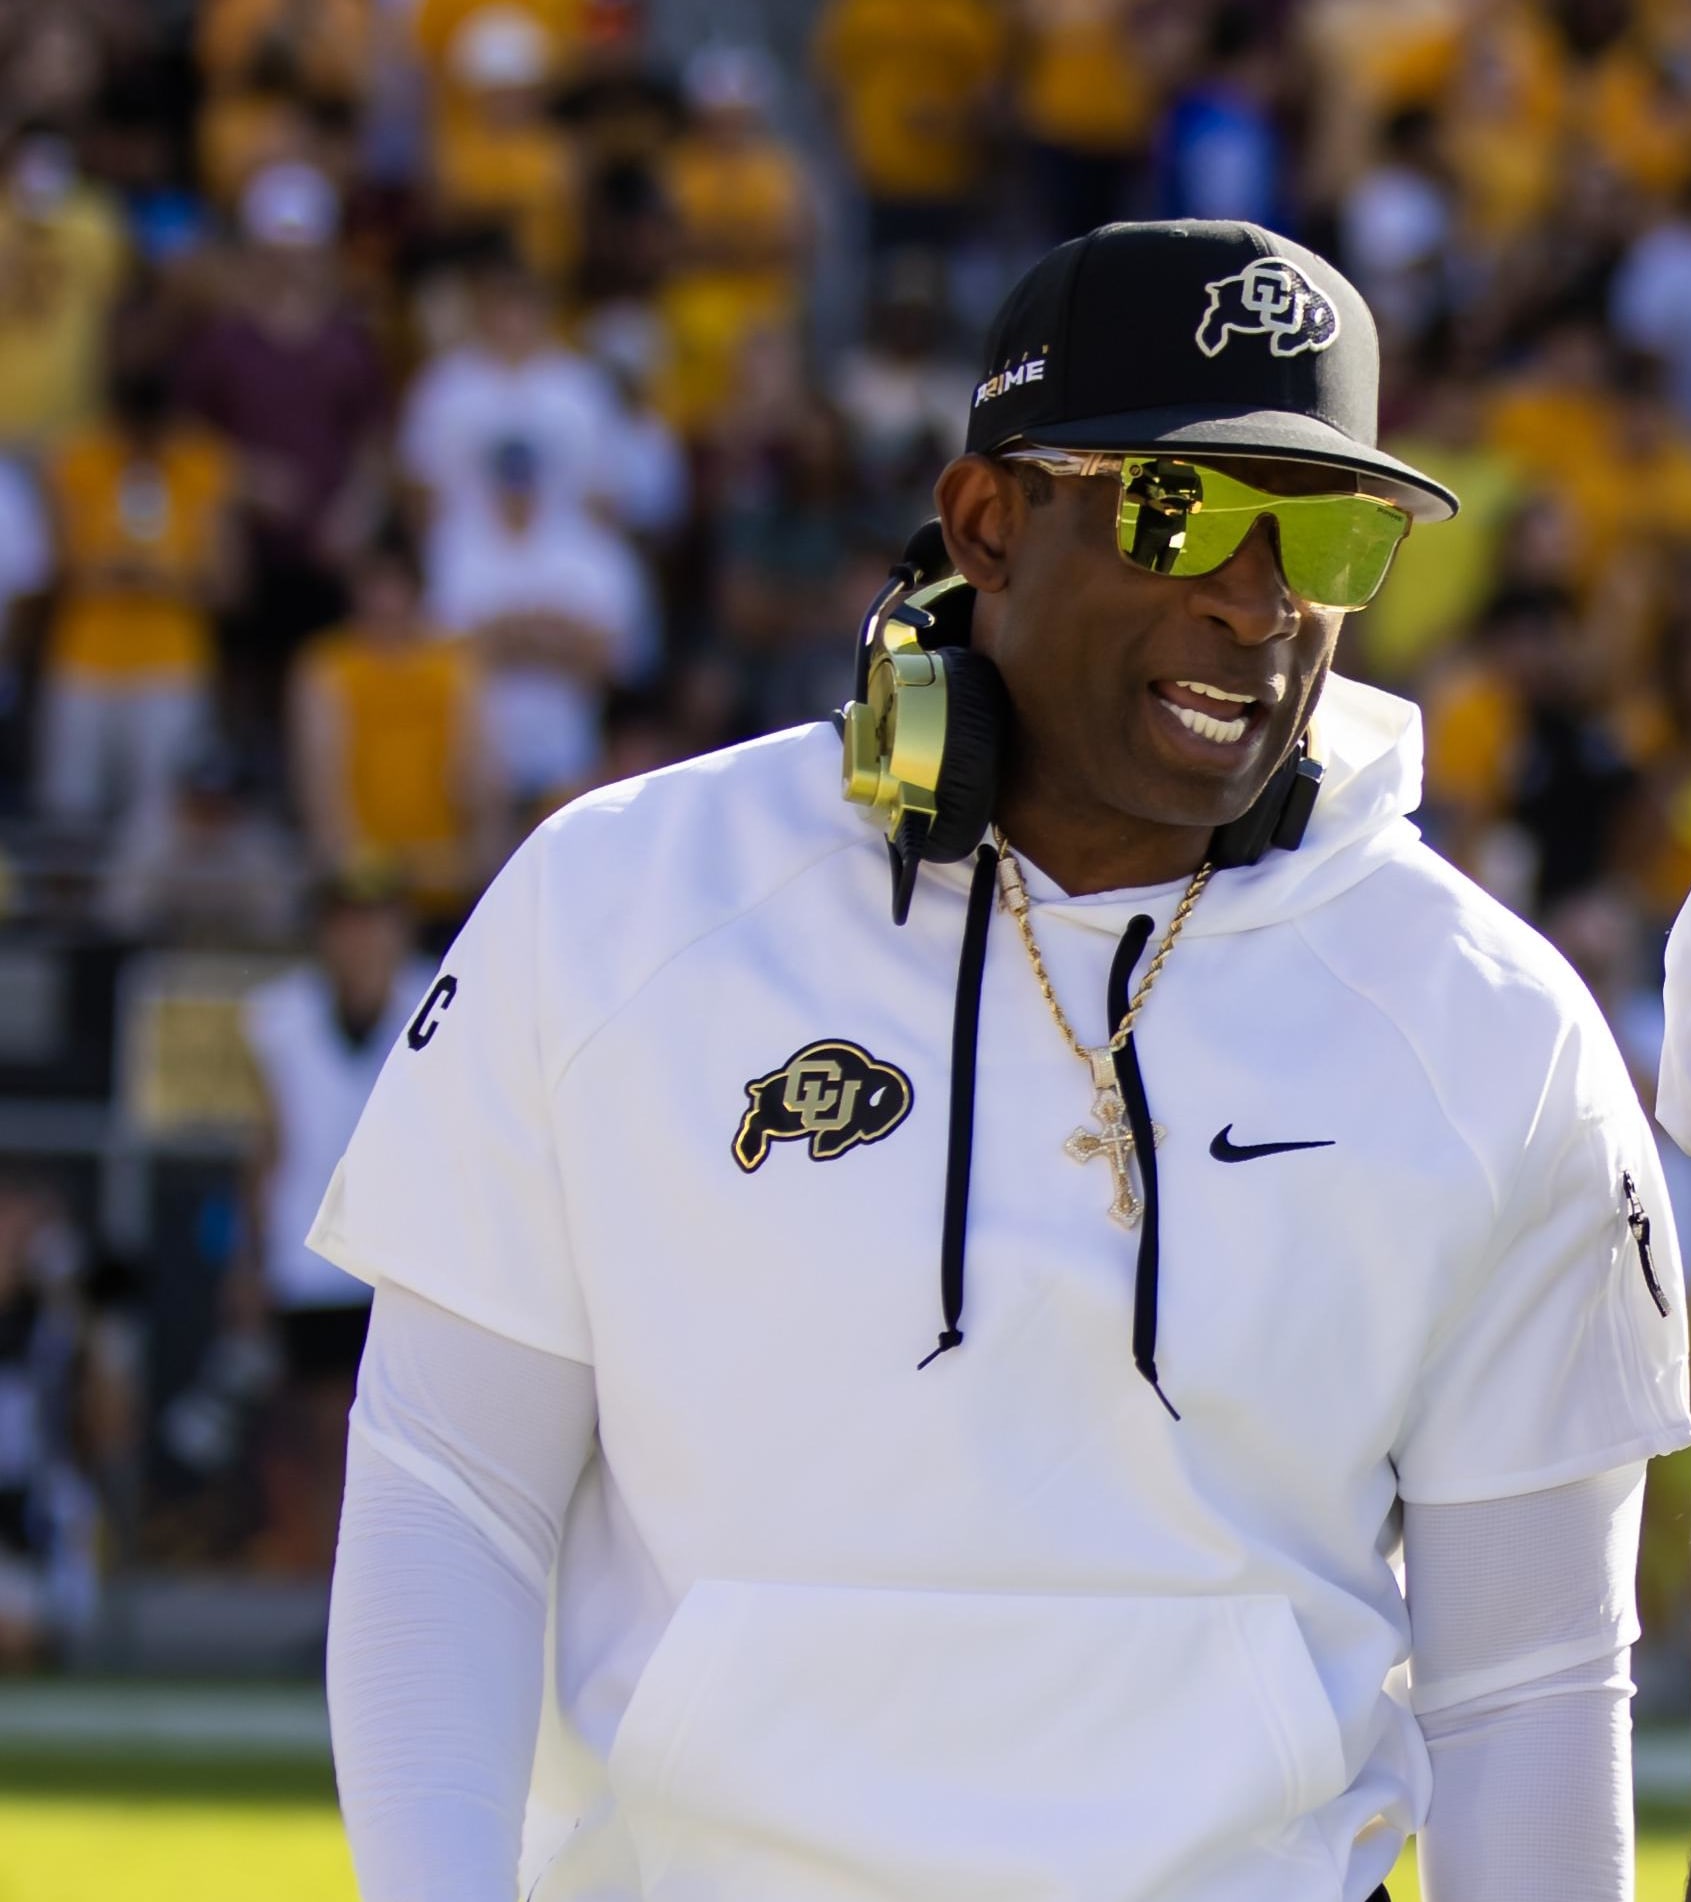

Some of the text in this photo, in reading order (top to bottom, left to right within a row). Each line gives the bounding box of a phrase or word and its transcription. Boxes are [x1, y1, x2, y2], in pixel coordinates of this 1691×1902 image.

[1241, 268, 1310, 335] CU
[407, 974, 458, 1052] C
[782, 1059, 863, 1131] CU
